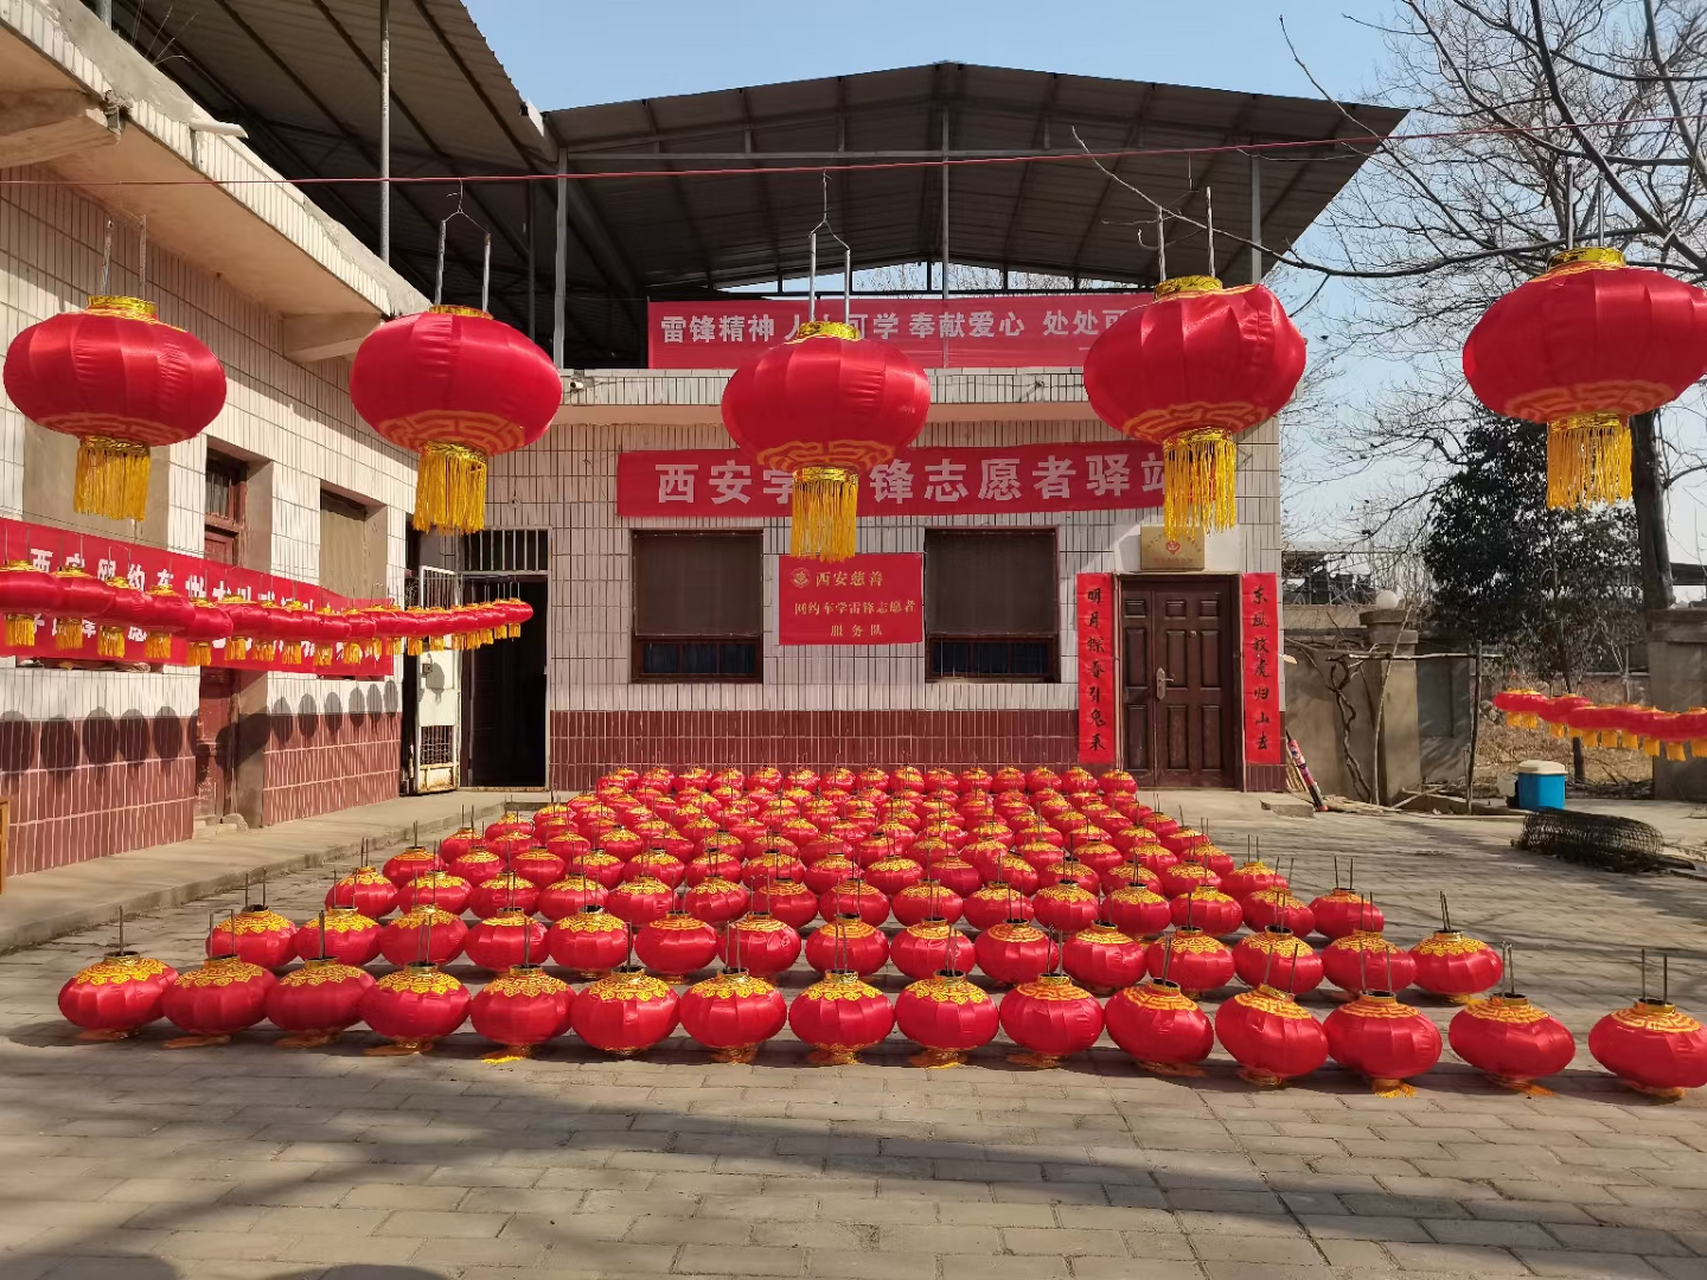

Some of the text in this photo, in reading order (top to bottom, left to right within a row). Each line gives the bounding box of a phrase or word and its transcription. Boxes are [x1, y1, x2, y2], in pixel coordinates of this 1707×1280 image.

[661, 313, 775, 343] 雷锋精神
[909, 310, 1025, 339] 奉献爱心
[816, 570, 883, 587] 西安慈善
[830, 623, 883, 638] 服务队
